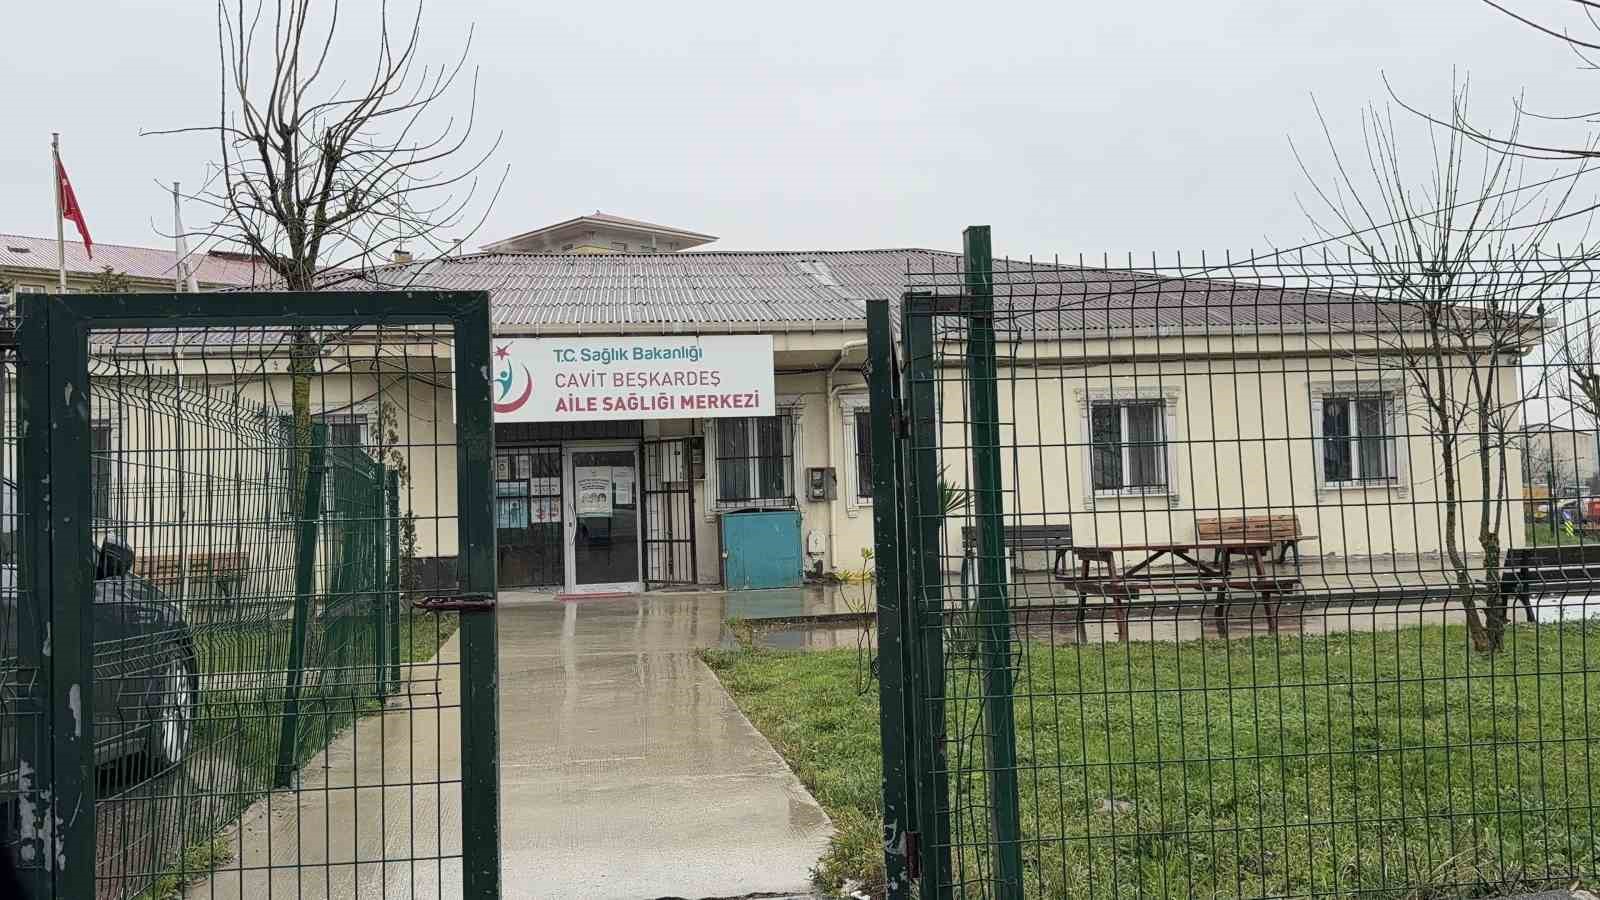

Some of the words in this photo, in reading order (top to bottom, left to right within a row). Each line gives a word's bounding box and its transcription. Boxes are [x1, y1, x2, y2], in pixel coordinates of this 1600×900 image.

[581, 347, 628, 365] Sağlık
[633, 346, 703, 363] Bakanlığı
[555, 370, 607, 388] CAVİT
[613, 371, 721, 389] BEŞKARDEŞ
[555, 394, 597, 412] AİLE
[603, 392, 674, 411] SAĞLIĞI
[680, 390, 760, 410] MERKEZİ
